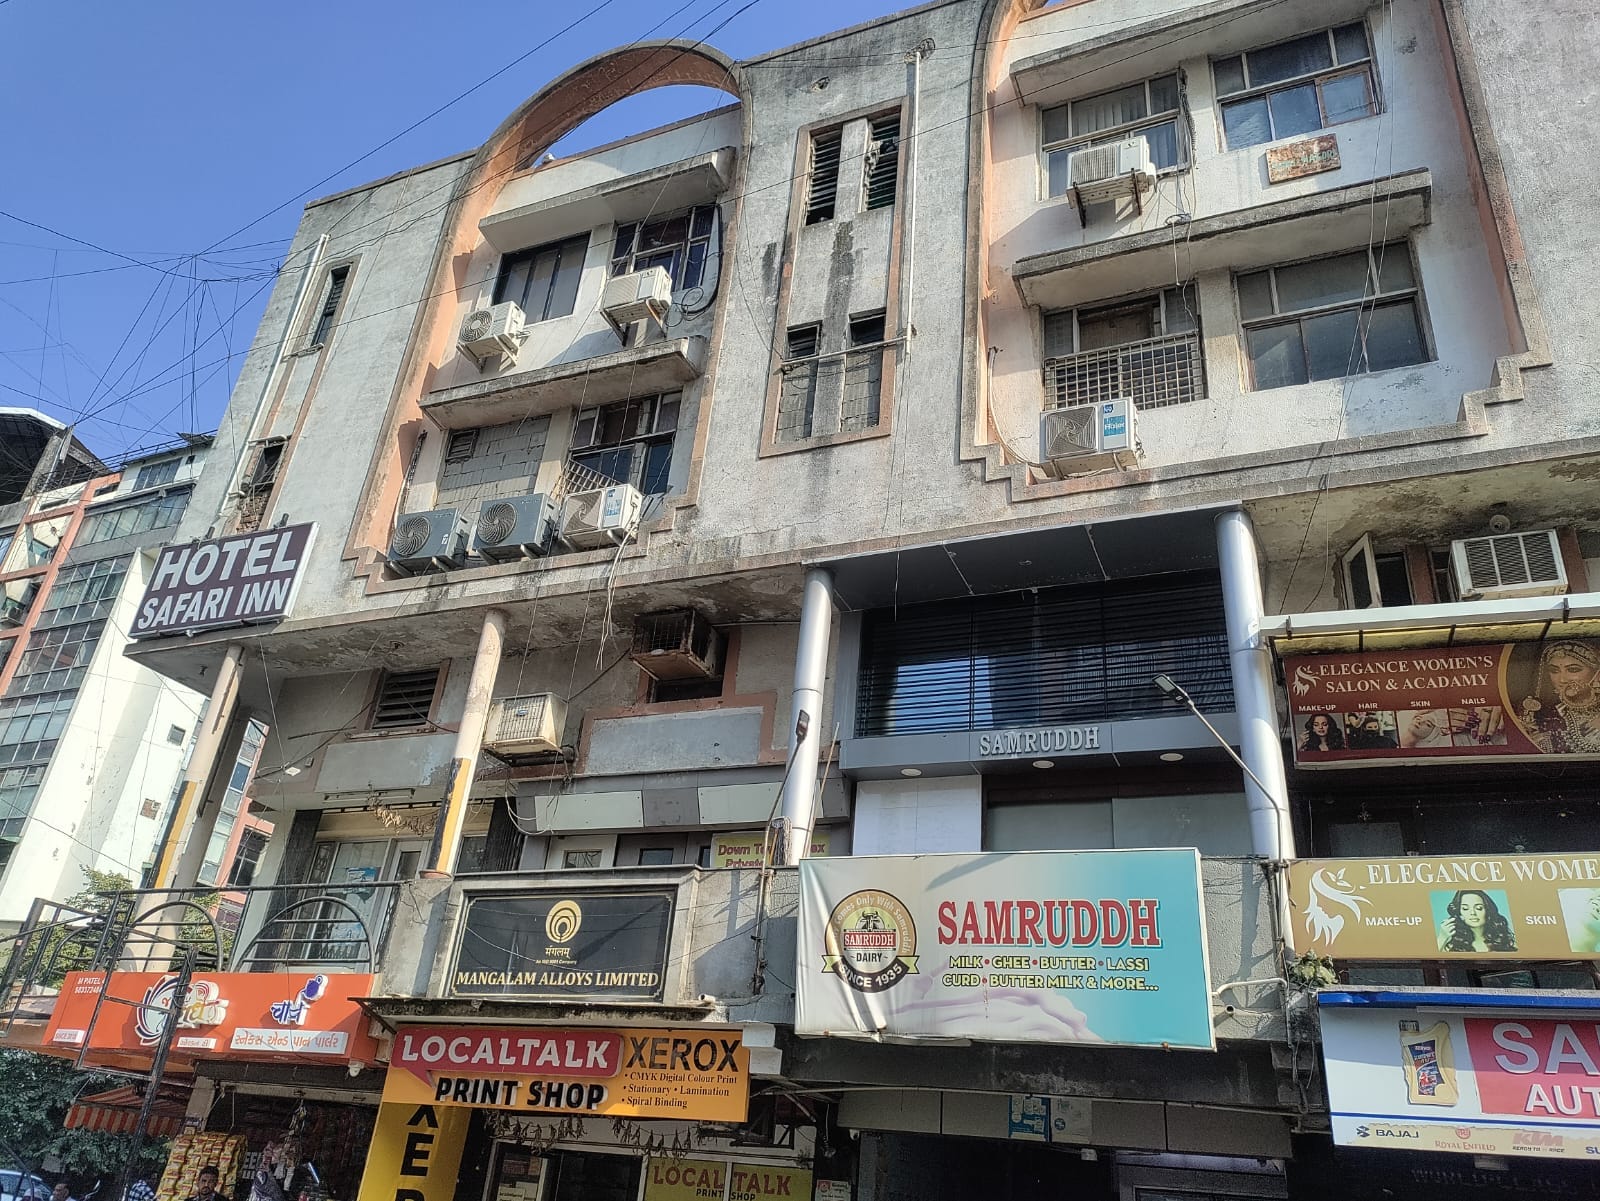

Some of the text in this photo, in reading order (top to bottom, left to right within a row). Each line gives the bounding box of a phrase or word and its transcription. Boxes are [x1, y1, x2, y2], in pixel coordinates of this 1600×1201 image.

[152, 532, 297, 591] HOTEL
[137, 578, 292, 630] SAFARI INN
[1319, 655, 1494, 676] ELEGANCE WOMEN'S
[1326, 673, 1489, 693] SALON & ACADAMY
[1298, 704, 1337, 712] MAKE-UP
[1358, 702, 1378, 710] HAIR
[1410, 700, 1431, 708] SKIN
[1461, 697, 1486, 705] NAILS
[979, 726, 1100, 756] SAMRUDDH
[717, 844, 751, 856] Down
[1366, 858, 1600, 884] ELEGANCE WOME
[856, 894, 875, 906] Only
[877, 896, 894, 911] With
[893, 908, 912, 953] Samruddh
[937, 898, 1163, 948] SAMRUDDH
[1365, 916, 1423, 927] MAKE-UP
[1525, 915, 1557, 926] SKIN
[844, 934, 894, 946] SAMRUDDH
[544, 944, 571, 960] मंगलम्
[856, 952, 883, 963] DAIRY
[949, 955, 1150, 972] MILK GHEE BUTTER LASSI
[456, 971, 659, 988] MANGALAM ALLOYS LIMITED
[838, 962, 903, 988] SINCE 1935
[942, 974, 1159, 992] CURD BUTTER MILK & MORE...
[293, 1036, 311, 1048] પાન
[1492, 1022, 1600, 1076] SA
[401, 1034, 611, 1069] LOCALTALK
[625, 1036, 741, 1073] XEROX
[630, 1071, 738, 1084] CMYK Digital Colour Print
[435, 1076, 608, 1111] PRINT SHOP
[628, 1083, 730, 1097] Stationary Lamination
[626, 1095, 688, 1109] Spiral Binding
[1375, 1128, 1420, 1139] BAJAJ
[1512, 1131, 1564, 1147] KTM
[1435, 1140, 1496, 1151] ROYAL ENFIELD
[653, 1165, 725, 1190] LOCAL
[733, 1171, 792, 1196] TALK
[695, 1188, 756, 1201] PRINT SHOP
